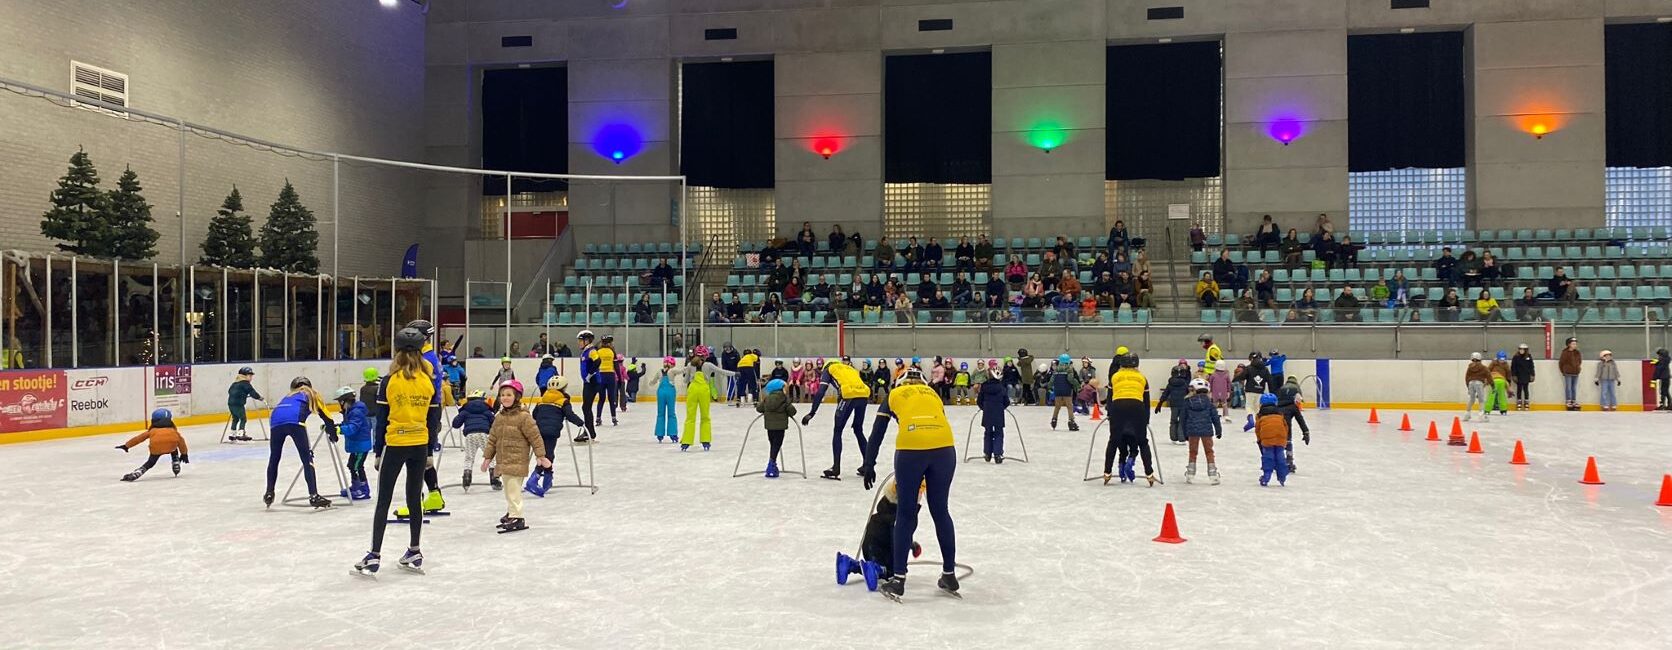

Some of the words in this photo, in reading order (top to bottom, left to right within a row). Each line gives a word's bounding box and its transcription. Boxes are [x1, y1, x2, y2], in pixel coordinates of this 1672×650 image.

[13, 374, 57, 392] stootje!
[74, 379, 105, 388] CCM
[156, 371, 175, 389] iris
[71, 398, 109, 411] Reebok
